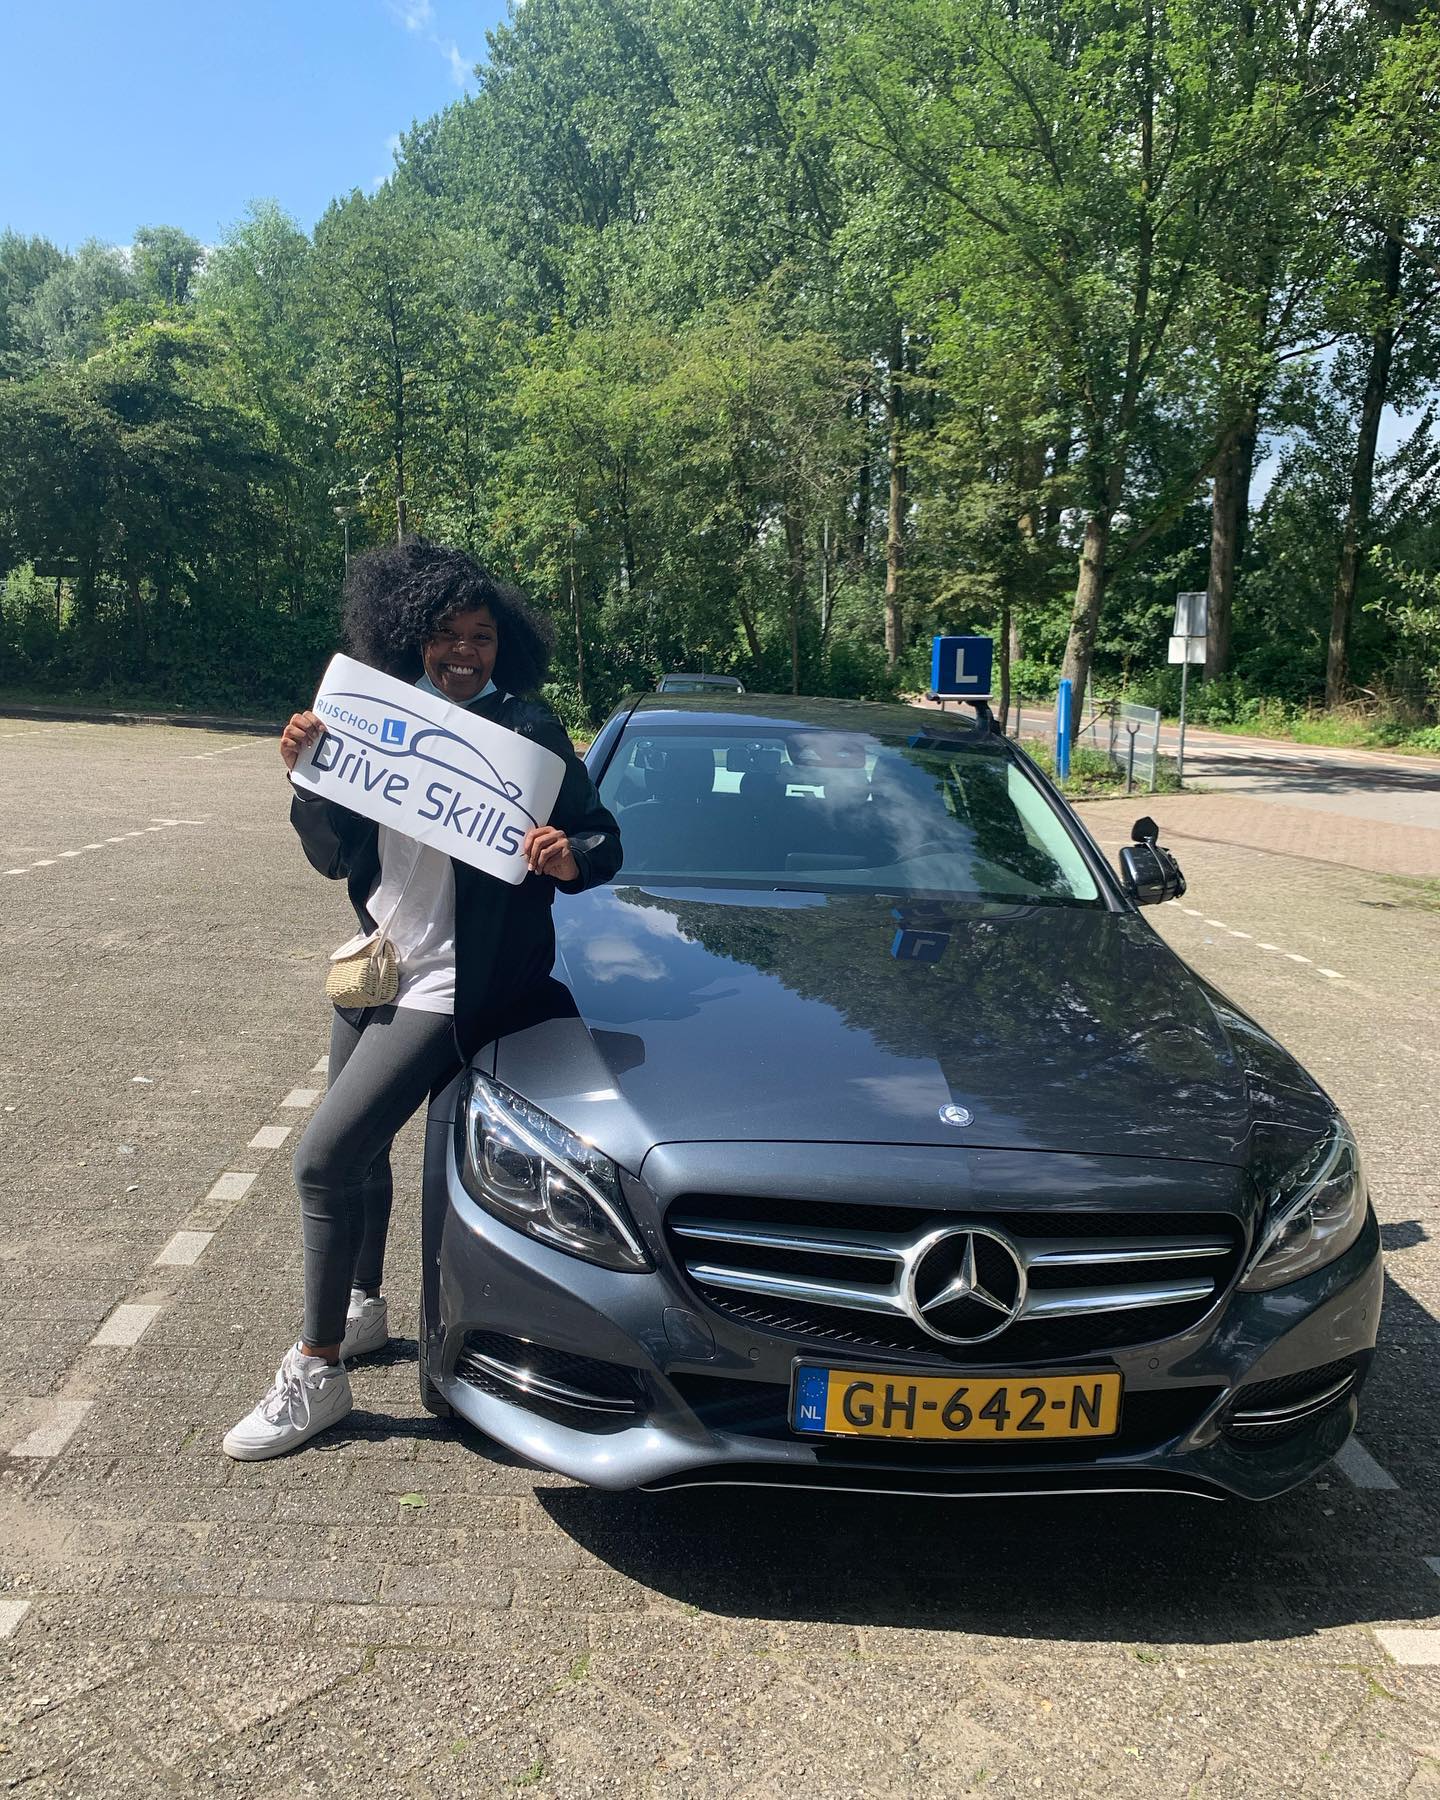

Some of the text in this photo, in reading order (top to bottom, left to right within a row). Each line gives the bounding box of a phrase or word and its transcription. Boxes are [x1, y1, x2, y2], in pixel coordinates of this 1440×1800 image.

[955, 648, 978, 684] L
[311, 731, 526, 856] Drive Skills
[801, 1380, 1103, 1432] NL GH-642-N
